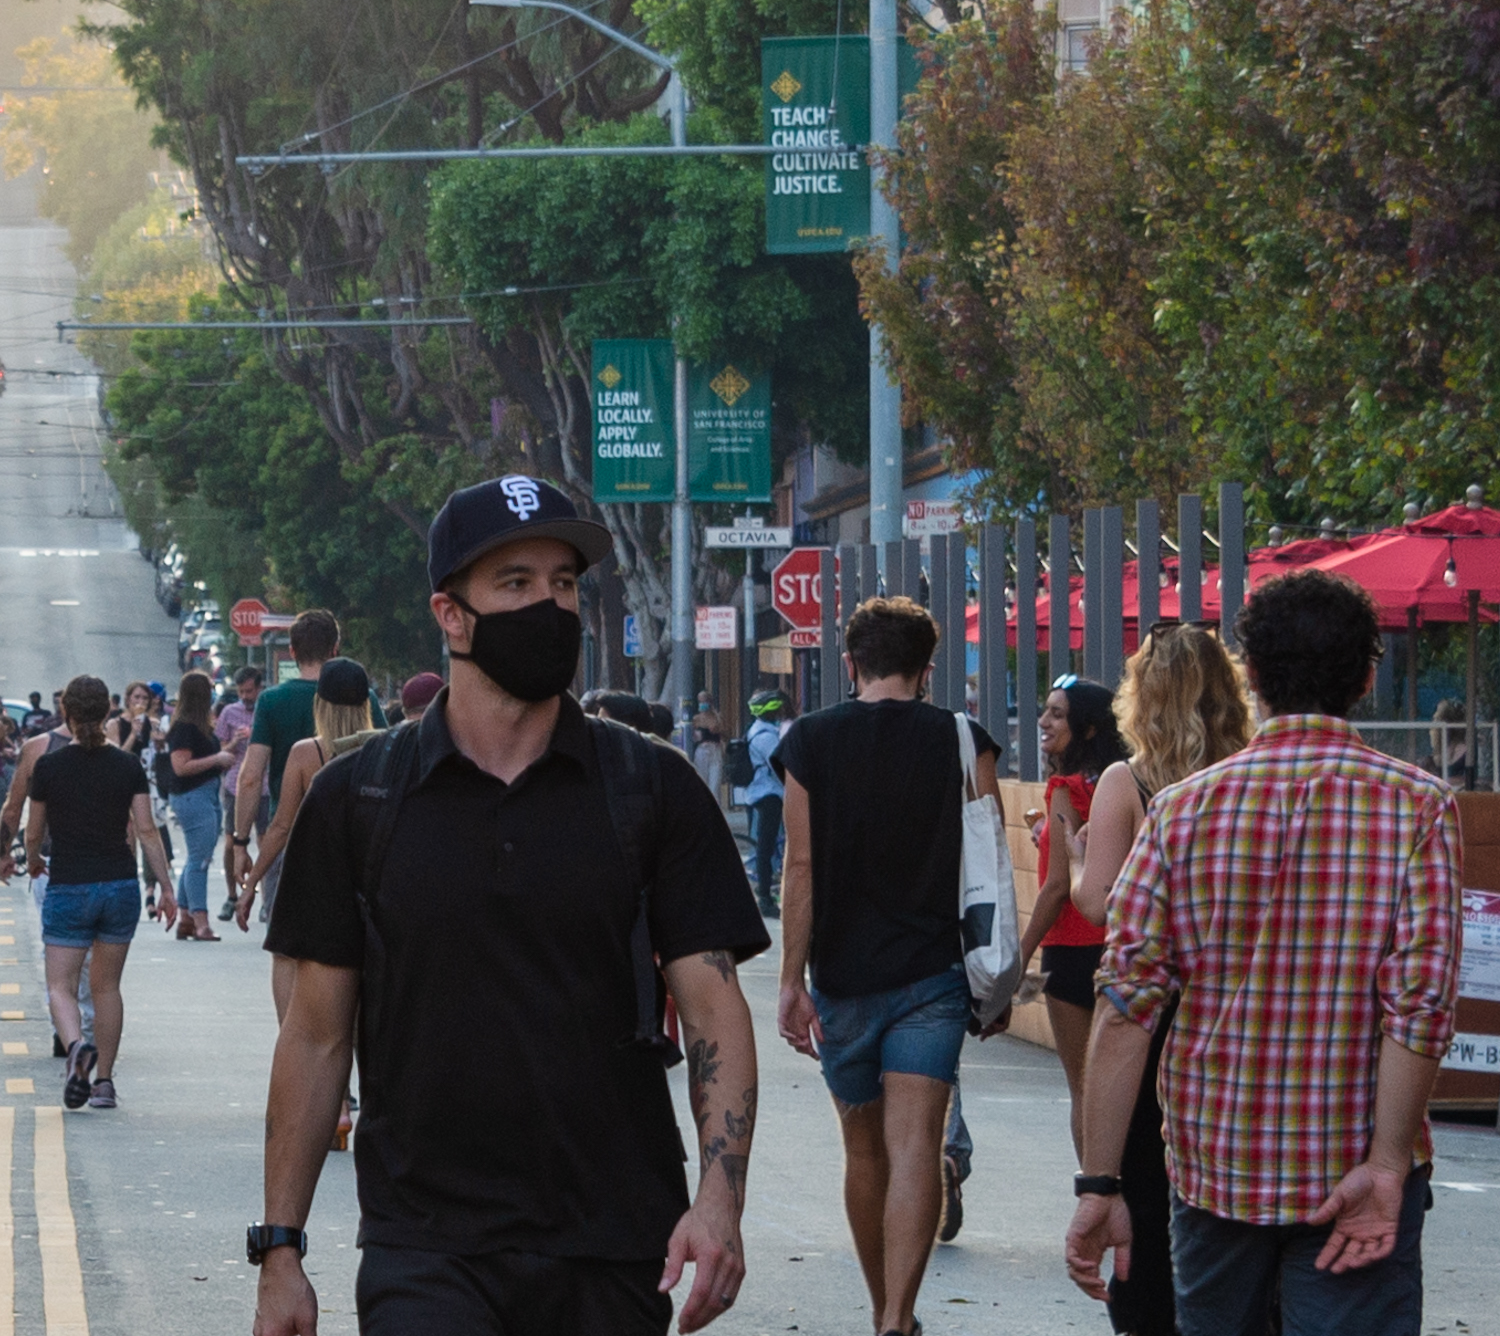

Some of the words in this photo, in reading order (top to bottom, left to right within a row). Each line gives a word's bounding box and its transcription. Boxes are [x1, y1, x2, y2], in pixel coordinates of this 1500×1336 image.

[772, 152, 860, 172] CULTIVATE
[772, 175, 843, 195] JUSTICE.
[597, 391, 639, 407] LEARN
[597, 408, 653, 424] LOCALLY.
[693, 409, 750, 419] UNIVERSITY
[752, 409, 766, 419] OF
[693, 420, 712, 429] SAN
[714, 420, 766, 429] FRANCISCO
[597, 425, 637, 441] APPLY
[597, 442, 663, 458] GLOBALLY.
[718, 531, 778, 544] OCTAVIA
